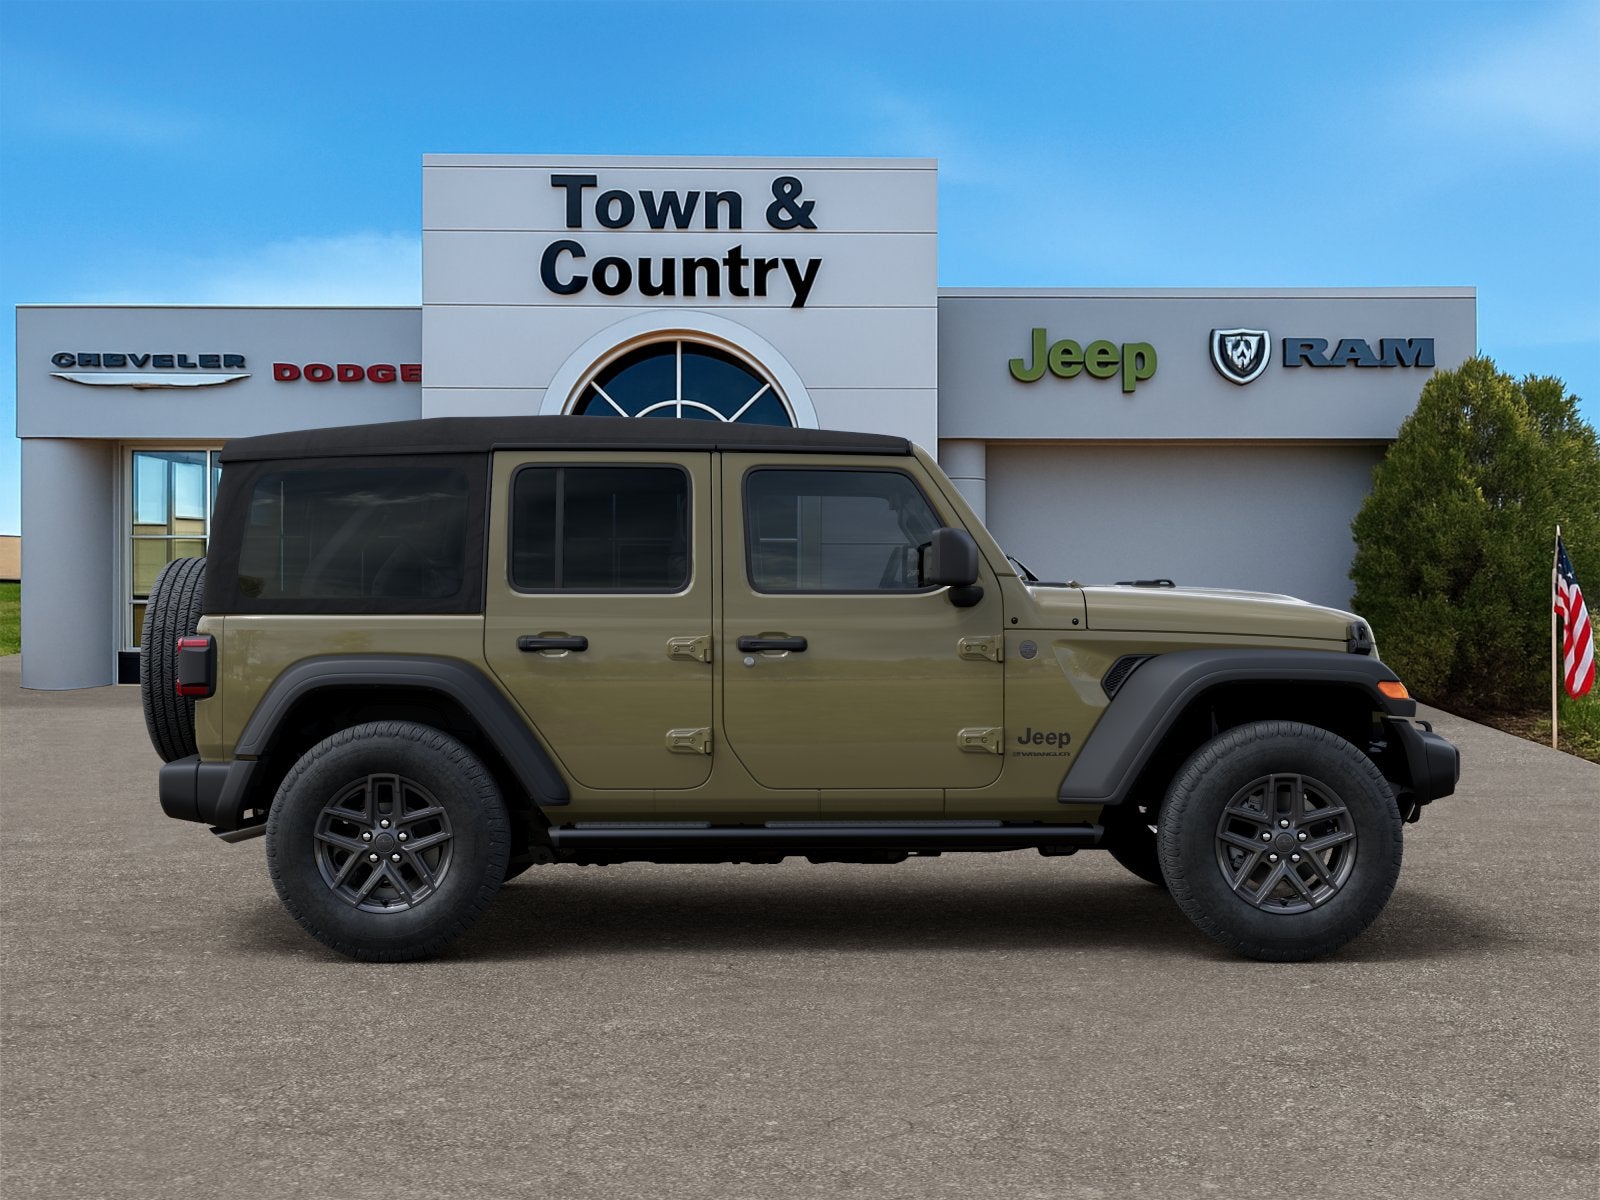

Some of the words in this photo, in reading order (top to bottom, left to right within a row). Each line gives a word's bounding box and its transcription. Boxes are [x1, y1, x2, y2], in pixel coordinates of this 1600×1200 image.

[550, 174, 742, 229] Town
[765, 176, 818, 230] &
[540, 239, 822, 308] Country
[1008, 328, 1158, 393] Jeep
[1282, 337, 1435, 367] RAM
[1018, 728, 1071, 748] Jeep
